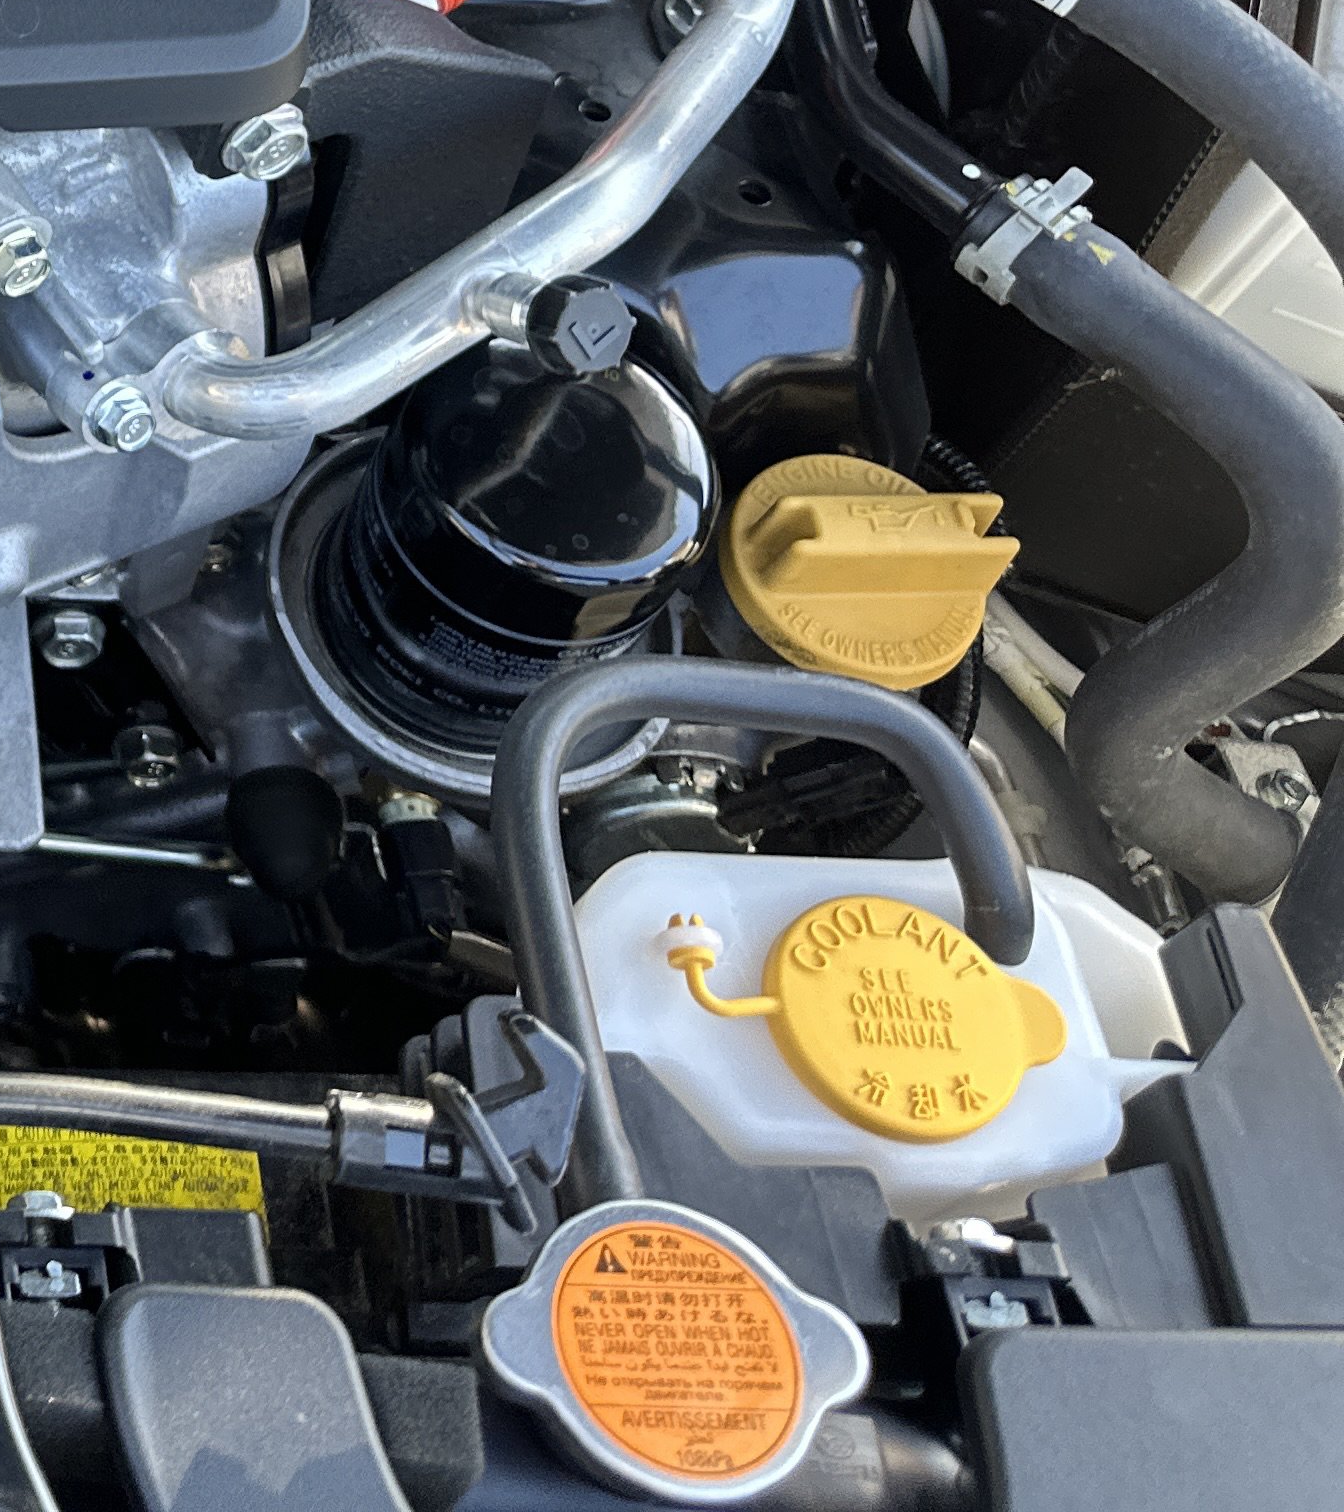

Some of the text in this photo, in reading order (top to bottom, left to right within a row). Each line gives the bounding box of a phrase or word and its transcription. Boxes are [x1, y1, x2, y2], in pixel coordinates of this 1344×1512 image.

[751, 458, 855, 506] ENGINE
[777, 600, 821, 637] SEE
[821, 629, 917, 668] OWNER'S
[790, 902, 989, 980] COOLANT
[859, 966, 914, 994] SEE
[849, 991, 954, 1024] OWNERS
[853, 1019, 962, 1052] MANUAL
[625, 1250, 721, 1269] WARNING
[573, 1321, 626, 1338] NEVER
[632, 1323, 677, 1339] OPEN
[682, 1324, 731, 1341] WHEN
[577, 1339, 595, 1355] NE
[655, 1340, 707, 1357] OUVRIR
[585, 1373, 608, 1386] Не
[622, 1410, 767, 1431] AVERTISSEMENT
